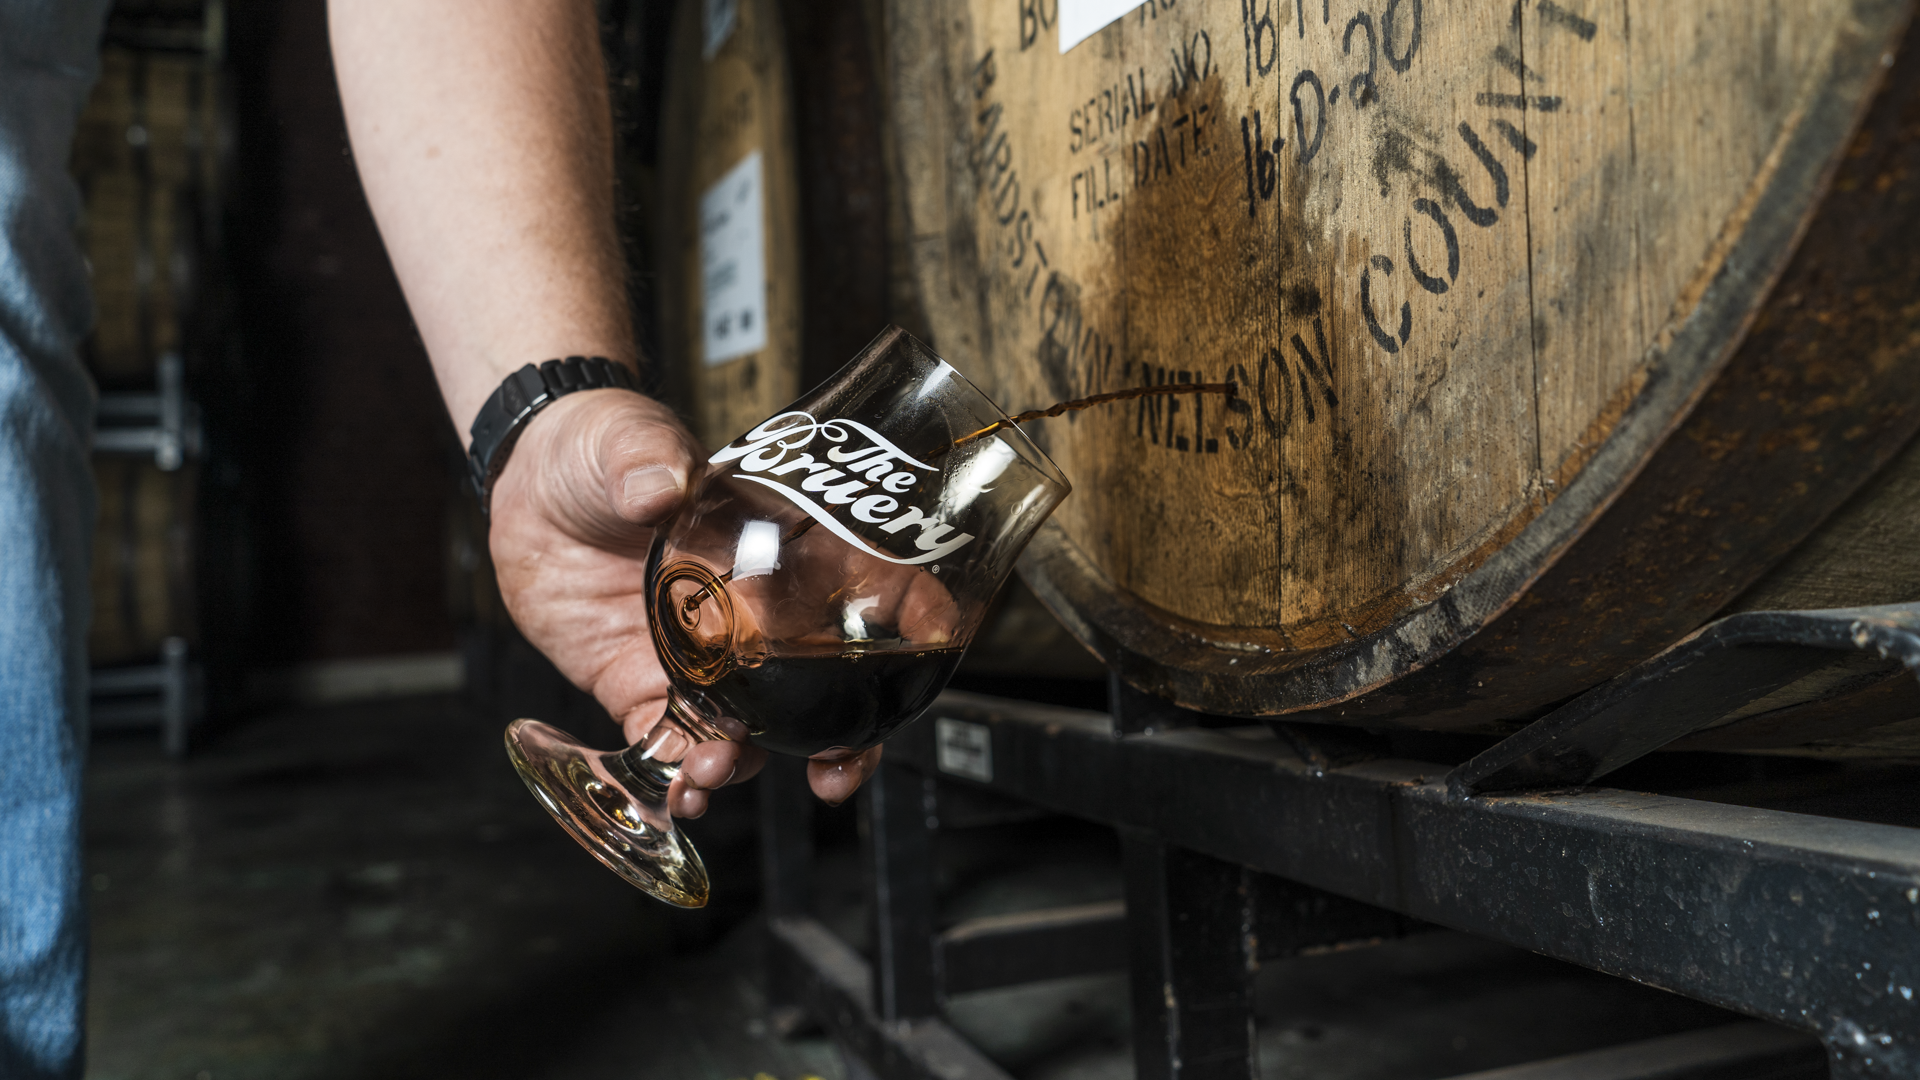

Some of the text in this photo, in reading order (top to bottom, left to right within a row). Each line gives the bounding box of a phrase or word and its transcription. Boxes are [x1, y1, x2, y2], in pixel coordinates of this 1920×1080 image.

[1069, 67, 1156, 154] SERIAL
[1071, 158, 1120, 220] FILL
[1137, 316, 1340, 454] NELSON
[708, 411, 975, 564] Bruery
[821, 418, 939, 493] The
